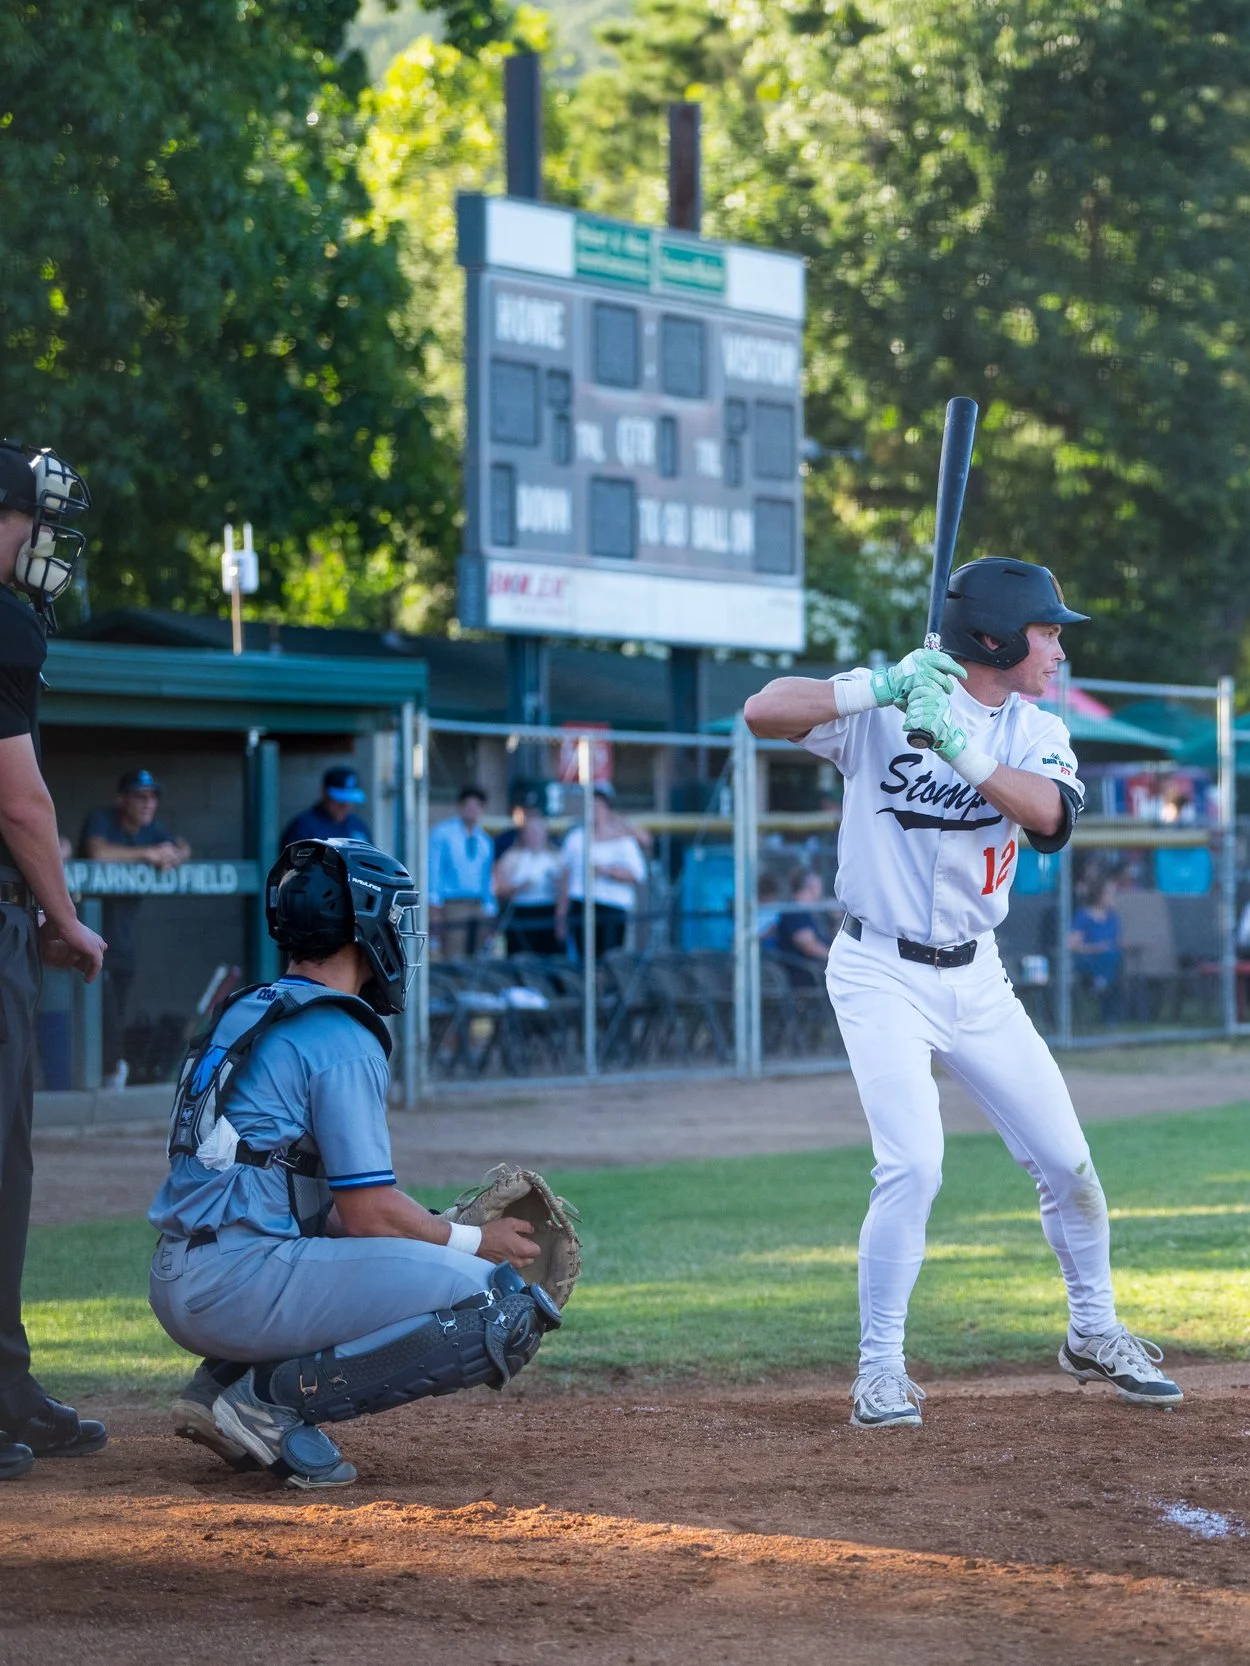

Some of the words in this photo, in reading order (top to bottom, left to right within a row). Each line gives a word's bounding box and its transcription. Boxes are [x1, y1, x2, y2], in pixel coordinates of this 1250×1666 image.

[496, 295, 565, 349] HOME
[880, 753, 987, 820] Stomp
[91, 863, 177, 893] ARNOLD
[179, 864, 238, 893] FIELD
[981, 839, 1015, 895] 12
